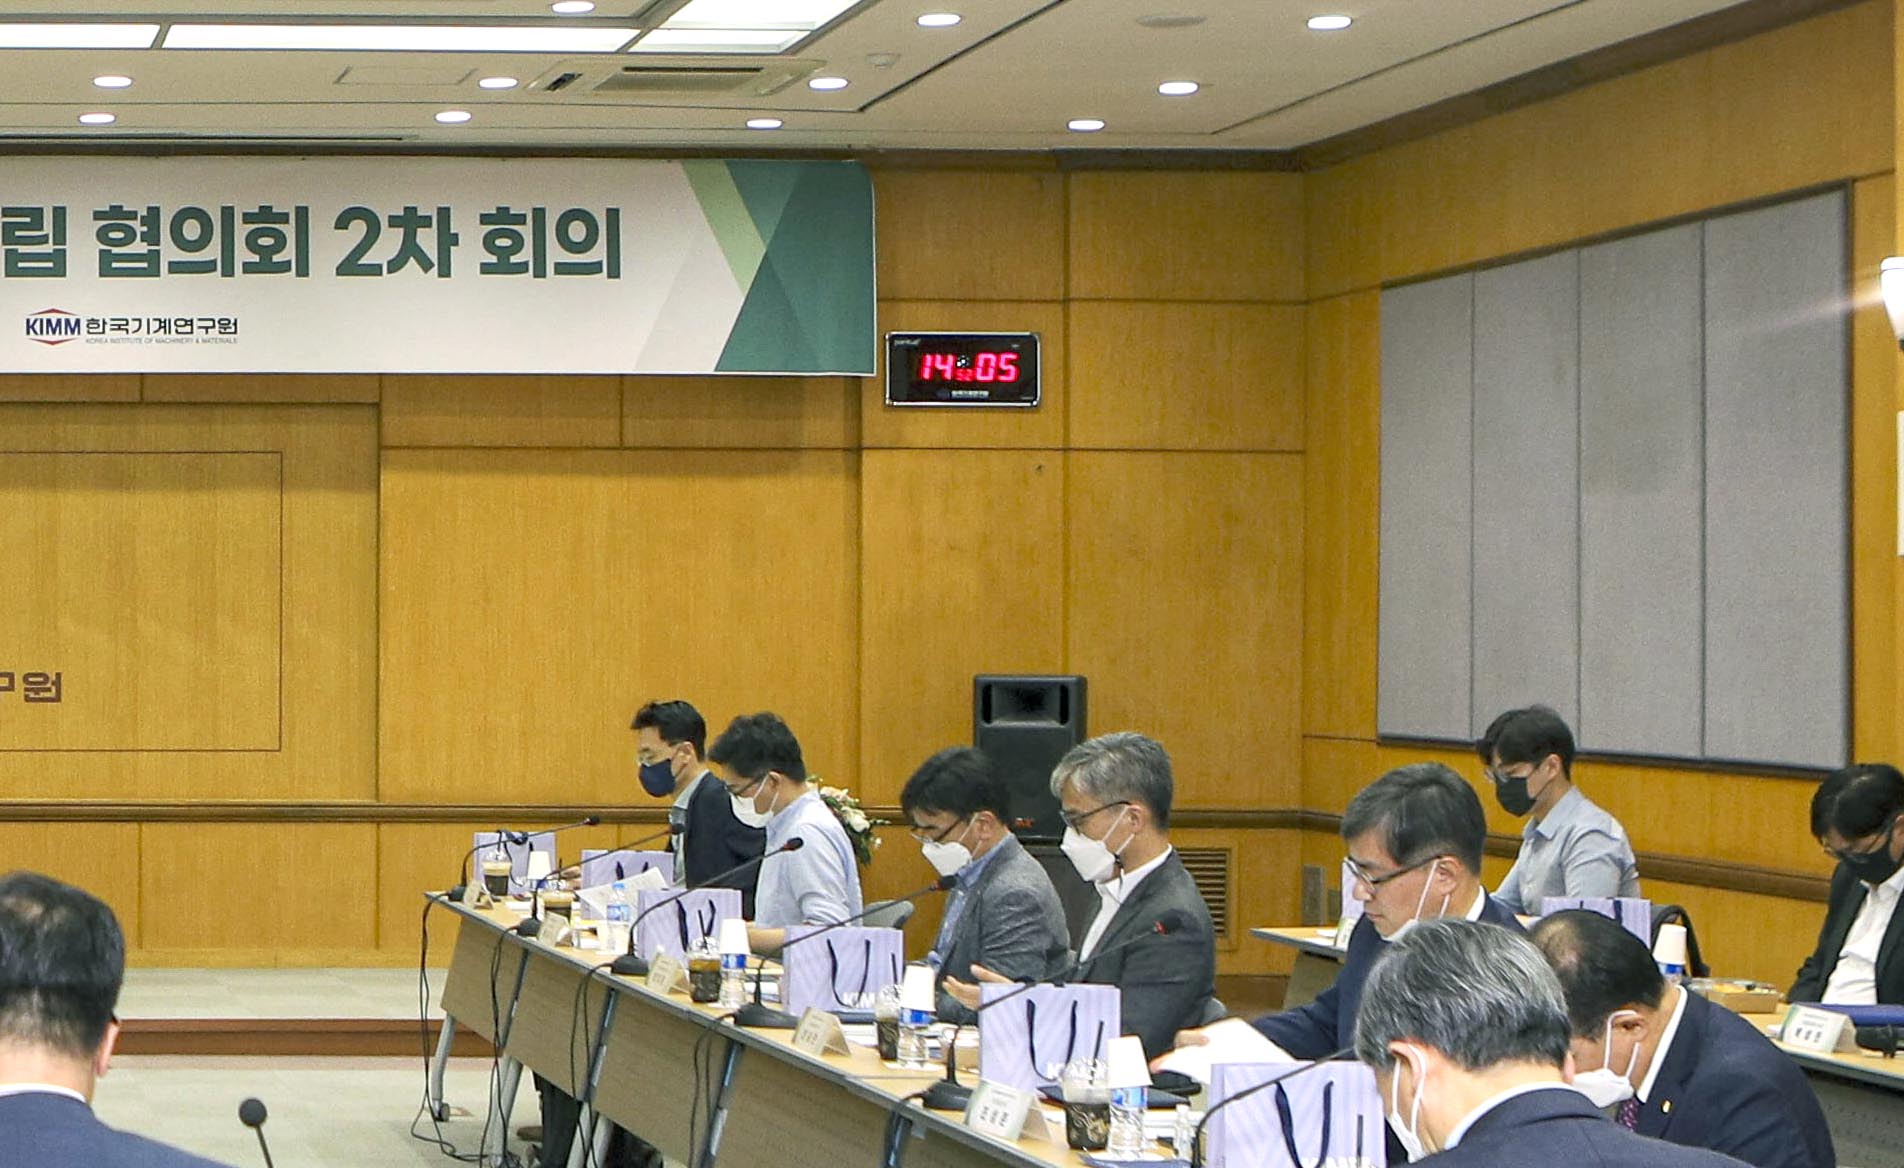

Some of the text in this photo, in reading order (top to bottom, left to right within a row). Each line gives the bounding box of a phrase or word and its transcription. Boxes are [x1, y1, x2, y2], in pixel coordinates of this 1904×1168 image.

[91, 204, 311, 279] 협의회
[332, 205, 461, 280] 2차
[478, 205, 622, 281] 회의
[25, 317, 238, 336] KIMM 한국기계연구원
